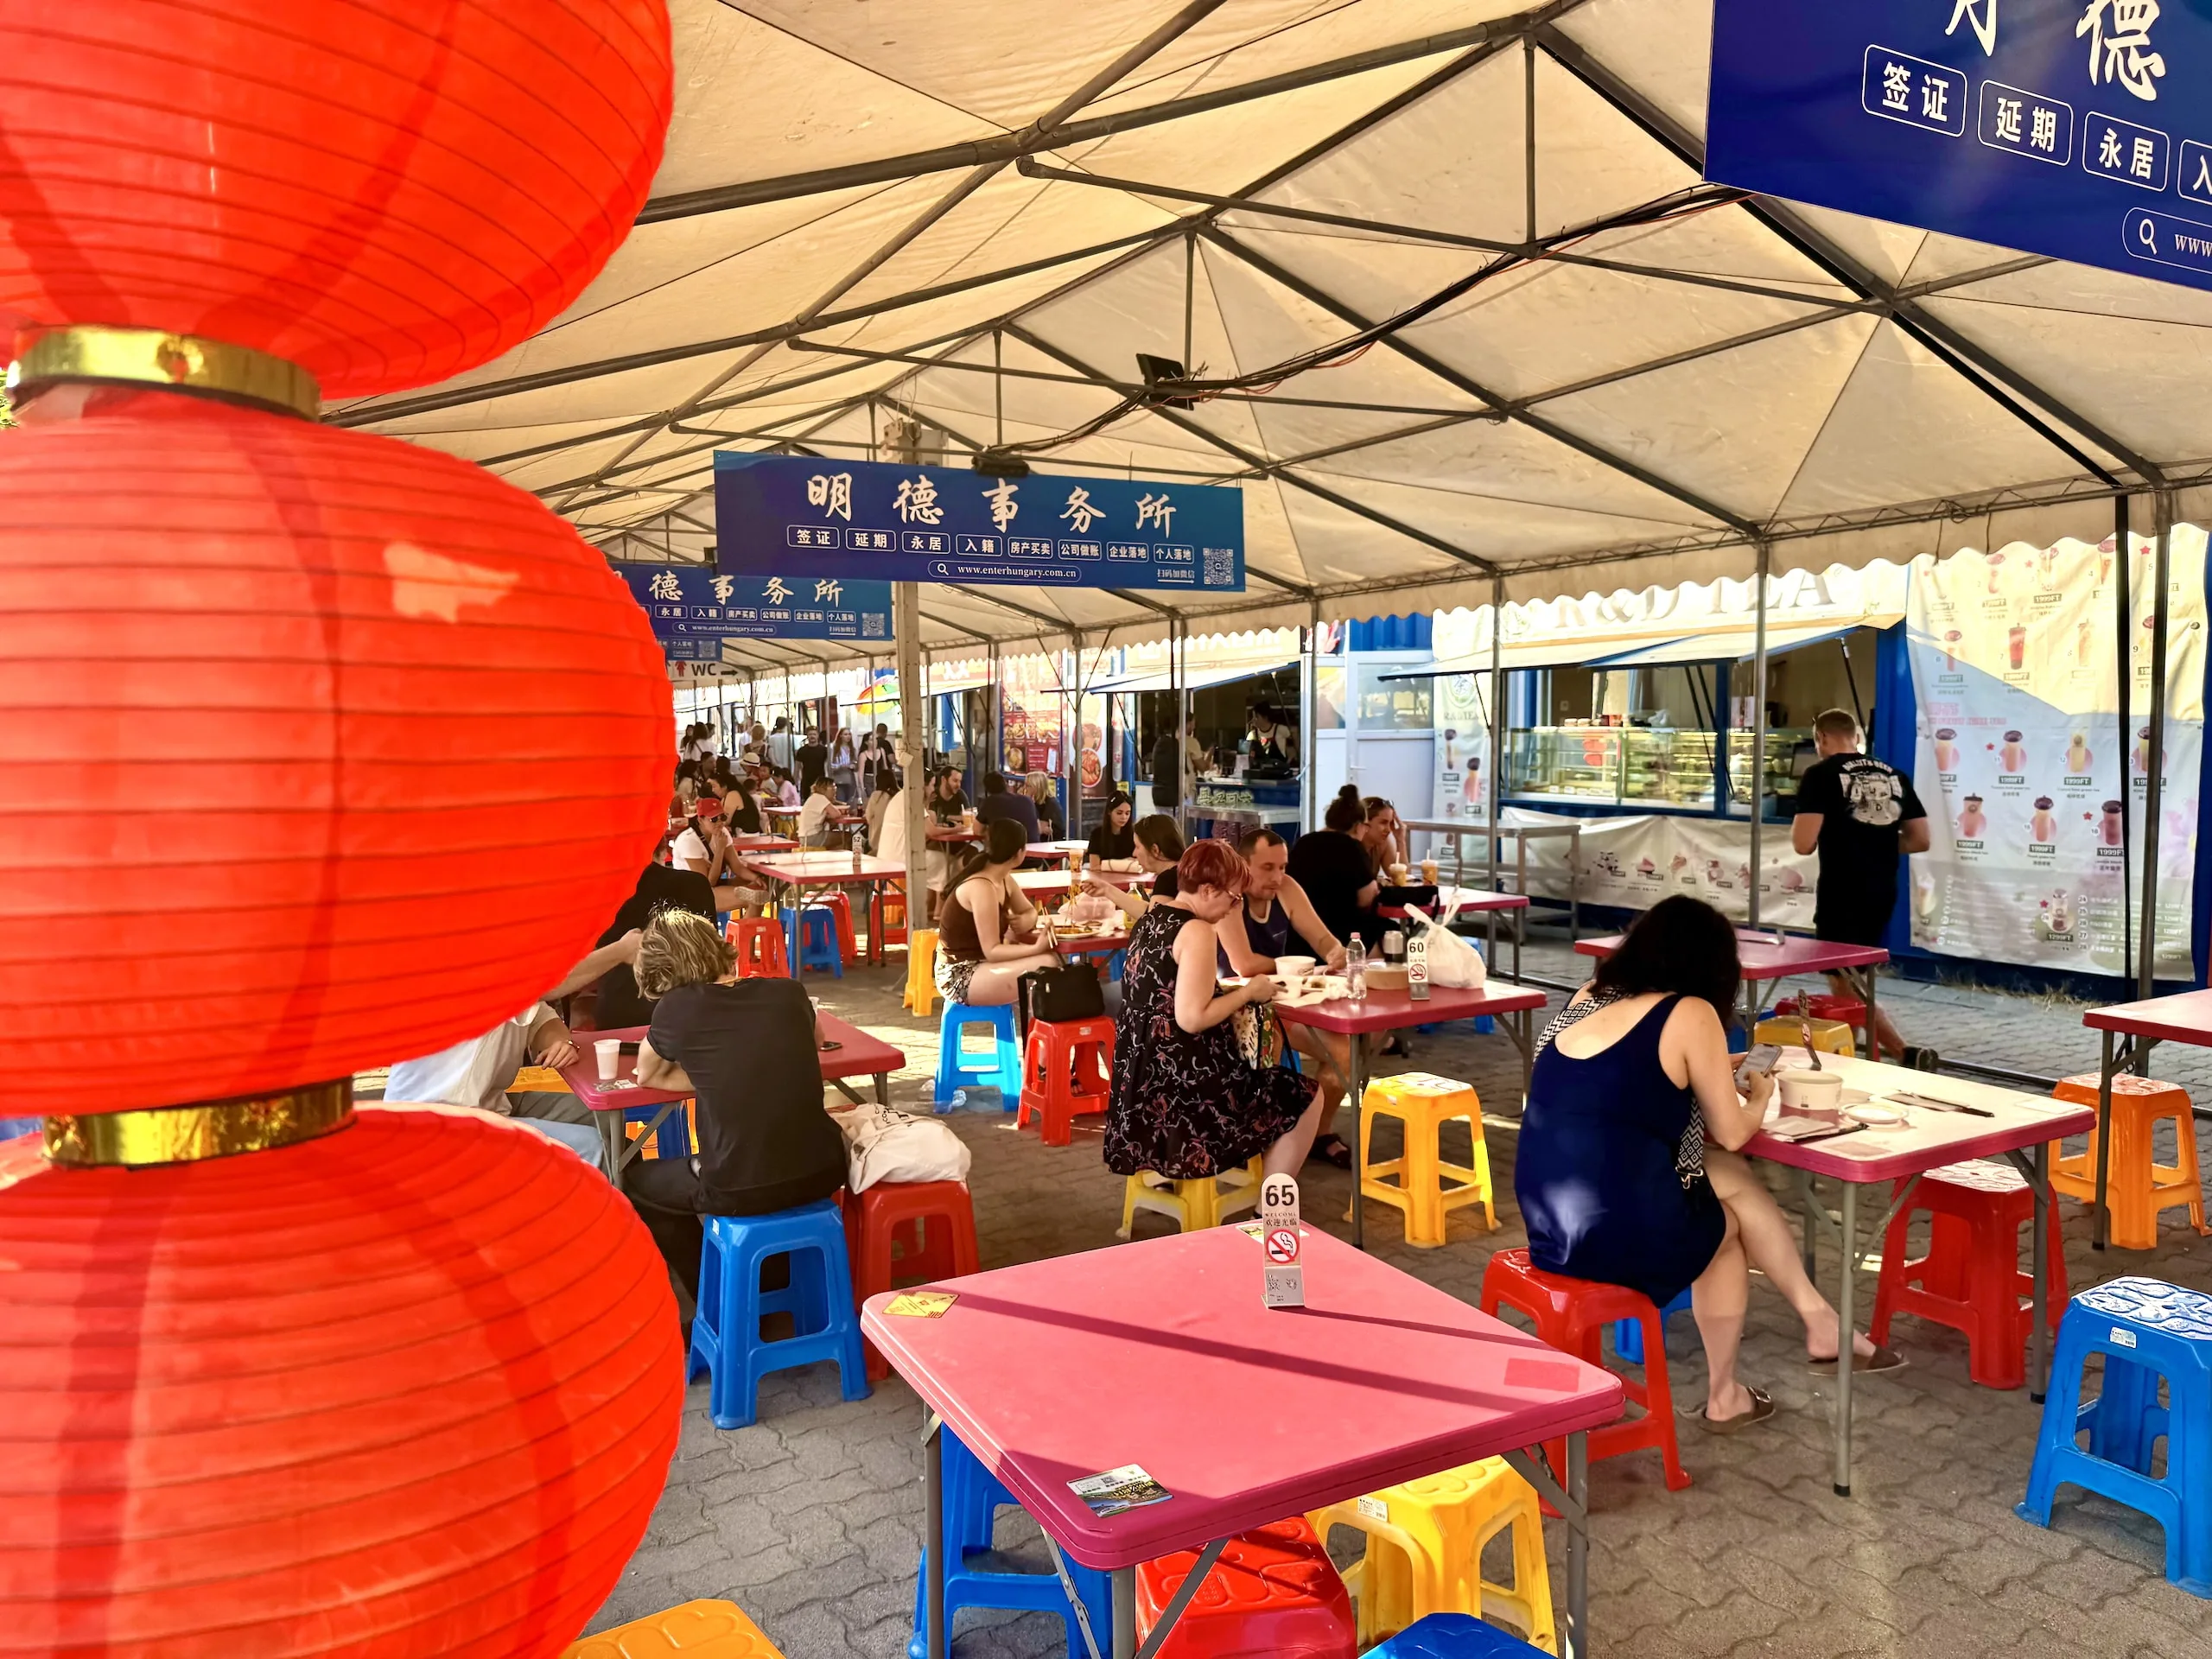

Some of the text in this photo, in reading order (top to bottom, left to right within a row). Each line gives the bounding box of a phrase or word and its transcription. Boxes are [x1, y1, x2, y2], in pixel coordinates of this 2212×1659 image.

[1944, 0, 2167, 101] 德
[1882, 60, 2212, 195] 签证 延期 永居 入
[807, 473, 1177, 538] 明德事务所
[797, 529, 1192, 561] 签证 延期 永居 入籍 房产买卖 公司做账 企业落地 个人落地
[957, 565, 1077, 578] www.enterhungary.com.cn
[614, 570, 843, 607] 德事务所
[691, 663, 717, 677] WC
[1409, 942, 1424, 953] 60
[1265, 1185, 1295, 1207] 65
